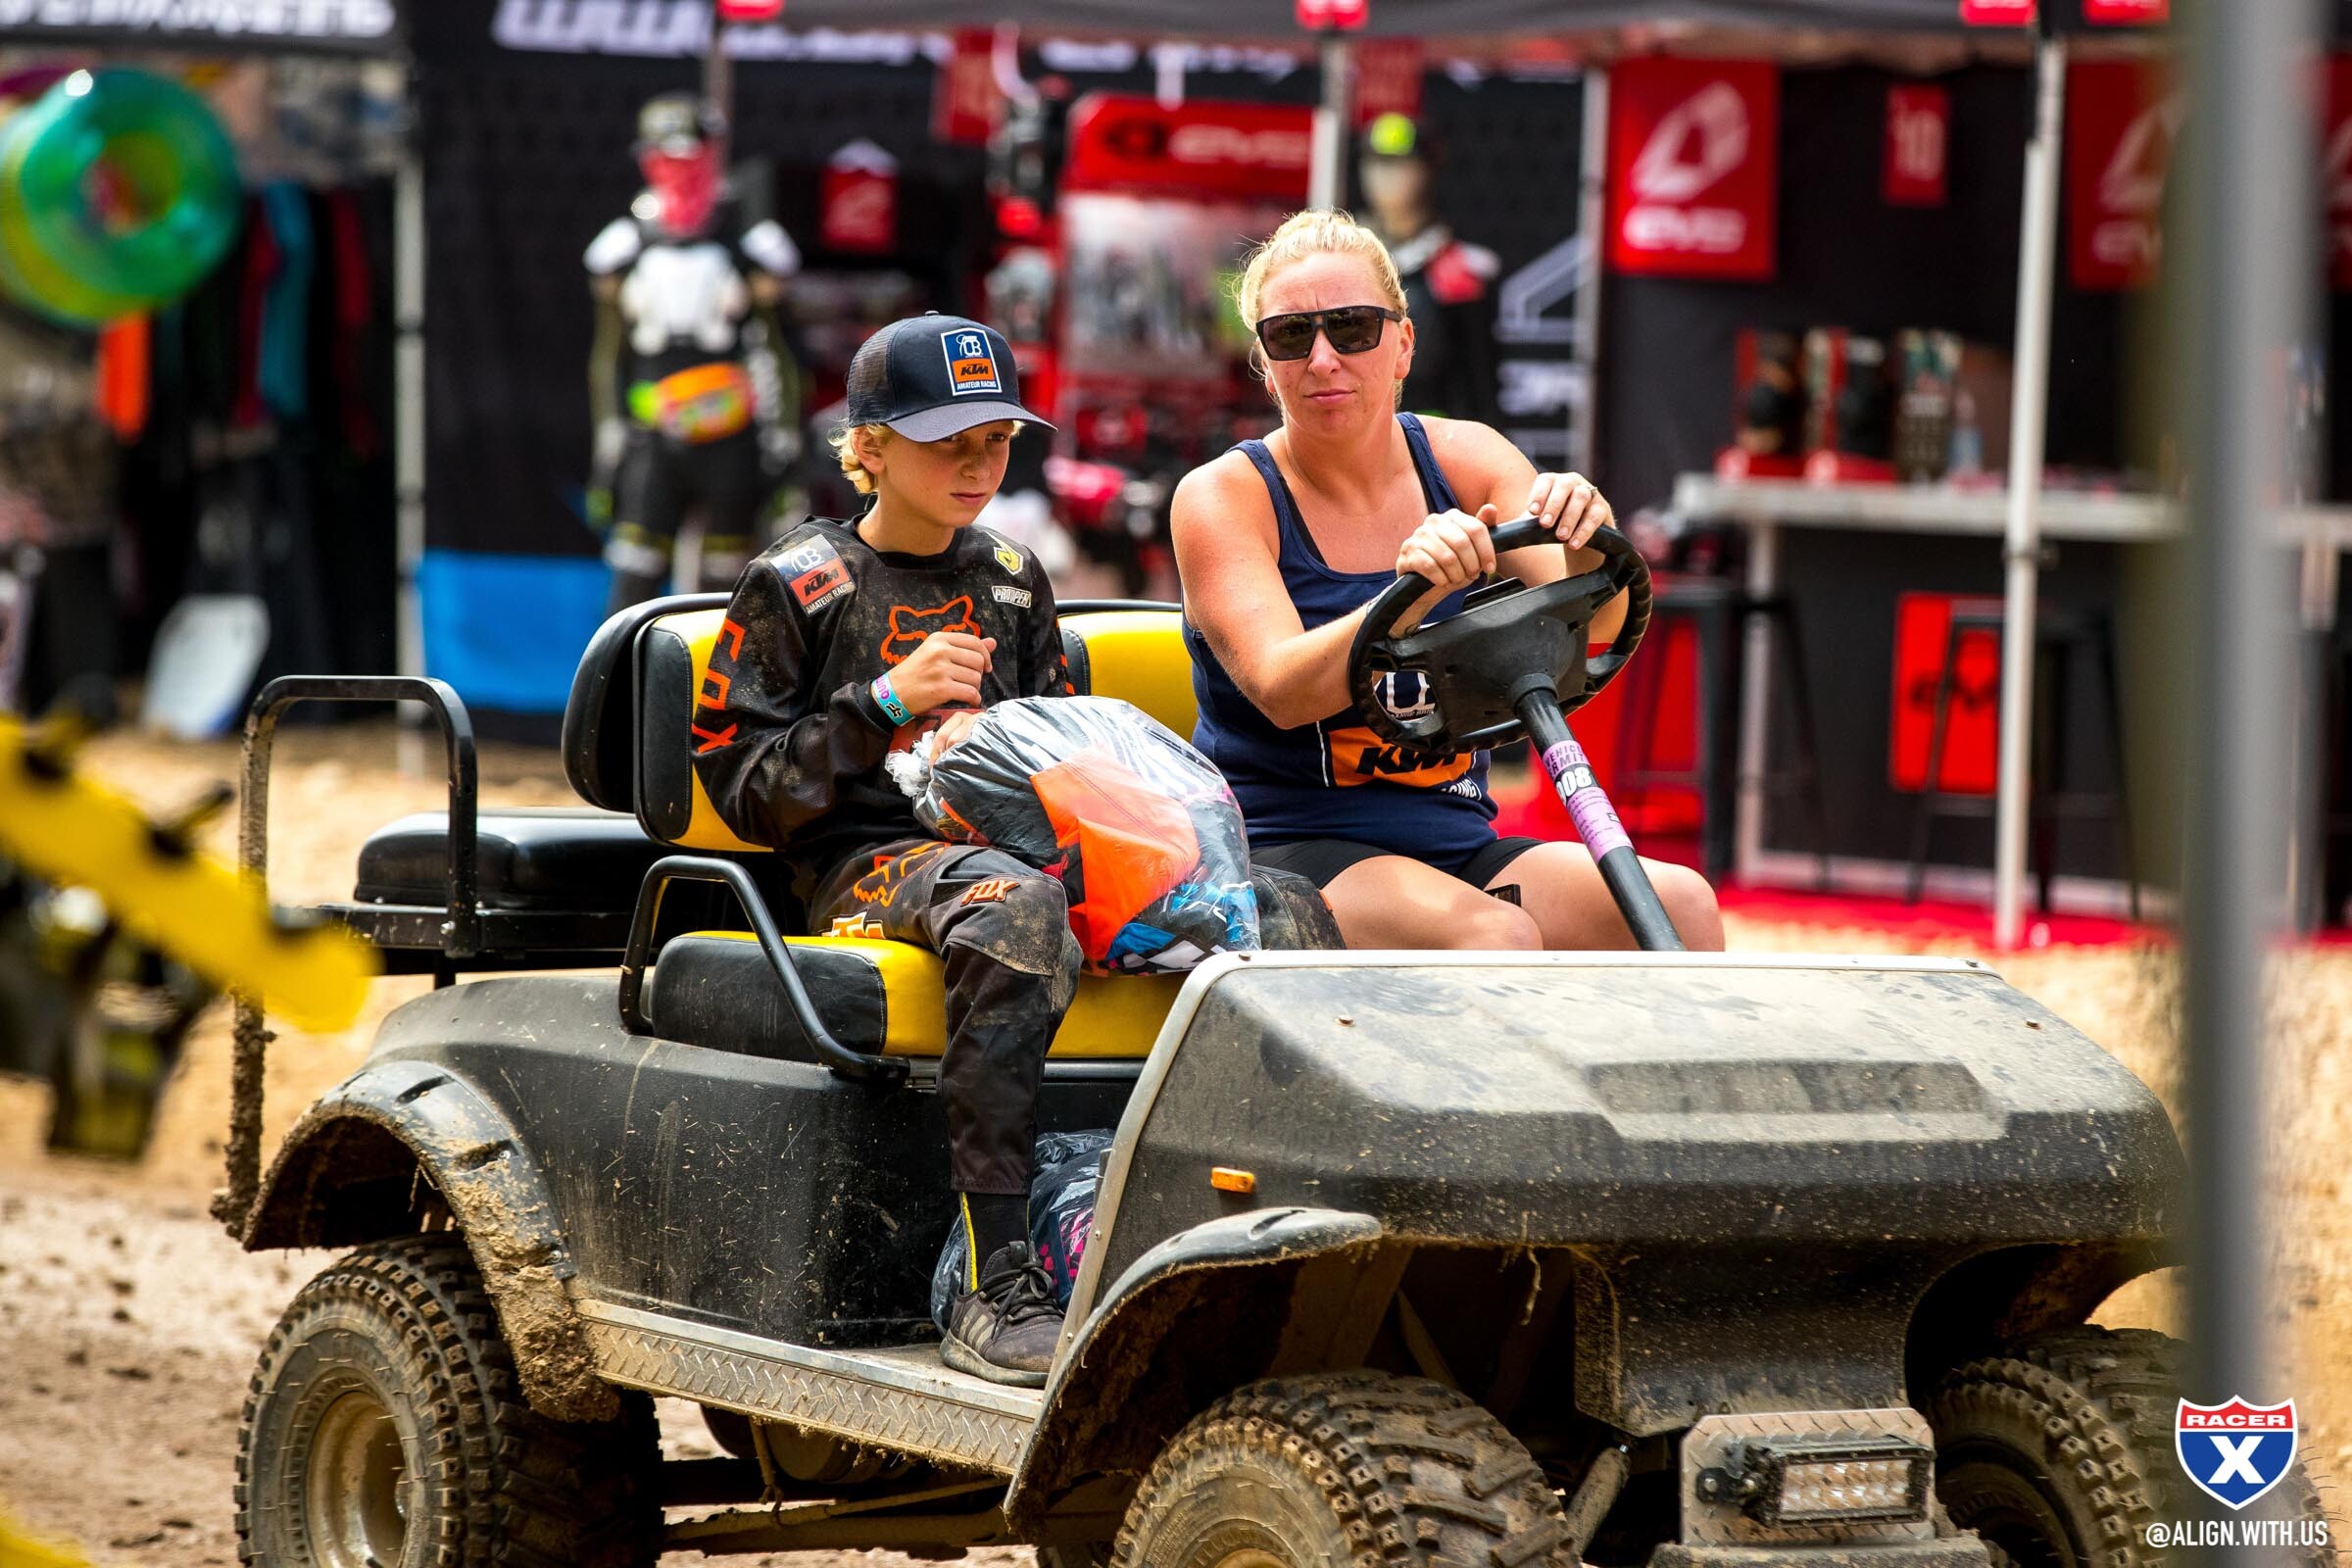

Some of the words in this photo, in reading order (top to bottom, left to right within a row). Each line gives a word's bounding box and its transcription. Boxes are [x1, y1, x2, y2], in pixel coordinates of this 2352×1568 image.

[960, 364, 989, 376] KTM
[956, 381, 981, 390] AMATEUR
[804, 568, 840, 597] KTM
[806, 591, 835, 614] AMATEUR
[960, 879, 1020, 907] FOX
